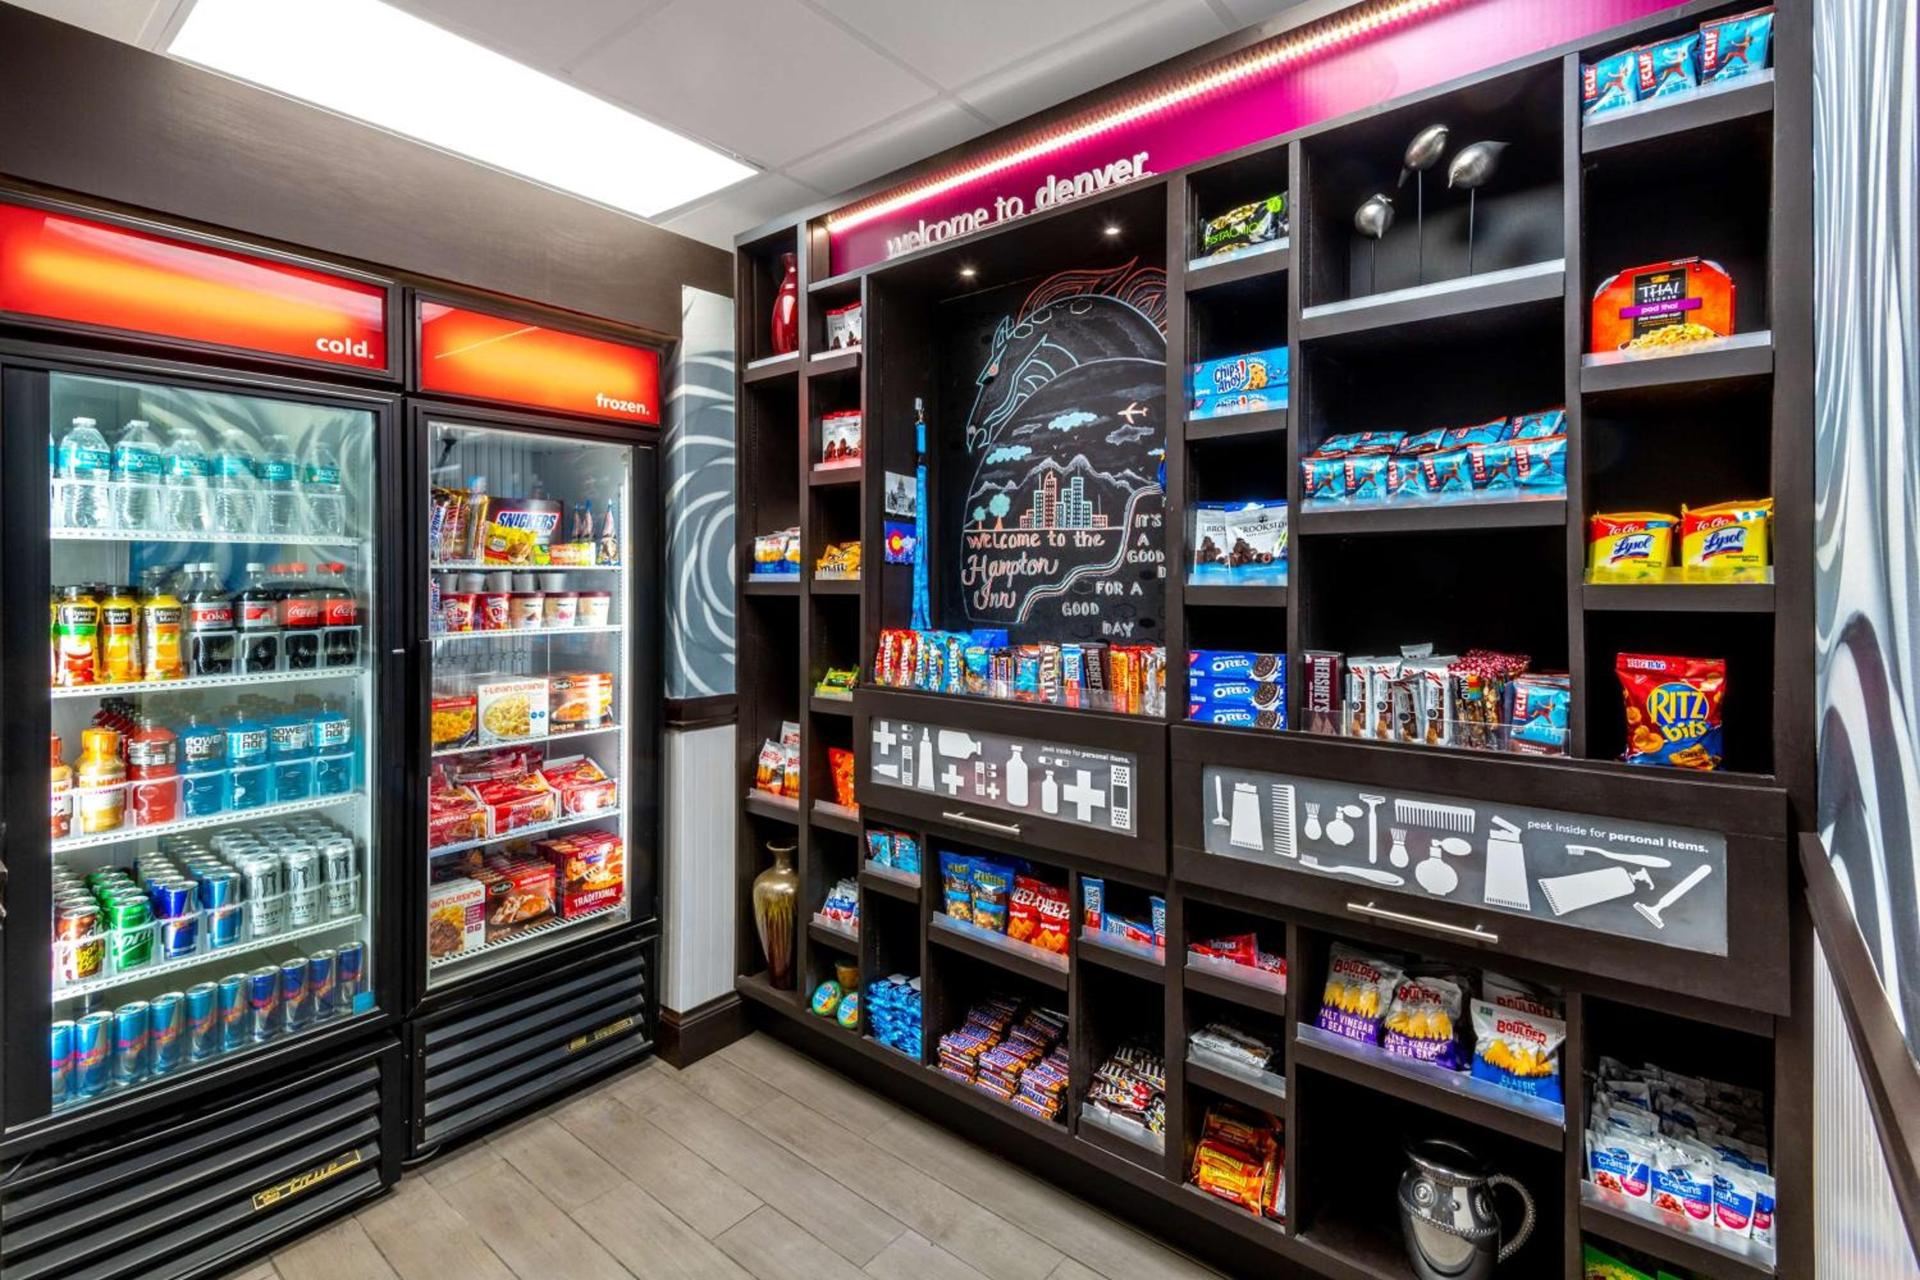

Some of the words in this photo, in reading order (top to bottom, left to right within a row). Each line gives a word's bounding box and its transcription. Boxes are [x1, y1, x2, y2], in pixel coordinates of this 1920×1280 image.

[1705, 31, 1718, 59] CLIF
[1640, 52, 1653, 78] CLIF
[1585, 66, 1597, 90] CLIF
[886, 206, 989, 257] welcome
[994, 196, 1024, 220] to
[1638, 282, 1679, 298] THAI
[1641, 305, 1660, 315] pad
[1661, 302, 1679, 313] thai
[316, 336, 375, 360] cold.
[1214, 362, 1240, 383] Chips
[595, 392, 650, 415] frozen.
[1472, 451, 1485, 473] CLIF
[1516, 446, 1529, 471] CLIF
[1609, 523, 1621, 535] To
[1622, 523, 1639, 533] Go
[1695, 520, 1709, 531] To
[1711, 518, 1729, 527] Go
[967, 531, 1041, 549] welcome
[1048, 530, 1066, 547] to
[1072, 531, 1106, 547] the
[1138, 533, 1150, 546] A
[1613, 534, 1652, 555] Lysol
[1704, 529, 1745, 550] Lysol
[1127, 550, 1165, 564] GOOD
[961, 551, 1060, 588] Hampton
[973, 582, 1017, 611] Inn
[1096, 581, 1124, 596] FOR
[1130, 581, 1143, 596] A
[201, 610, 228, 621] Coke
[1062, 602, 1100, 617] GOOD
[1102, 621, 1135, 637] DAY
[1212, 659, 1250, 671] OREO
[1213, 686, 1251, 698] OREO
[1314, 657, 1330, 713] HERSHEY'S
[1460, 676, 1470, 700] KIND
[1516, 688, 1529, 710] CLIF
[1650, 688, 1705, 724] RITZ
[1214, 713, 1251, 725] OREO
[1661, 719, 1707, 742] bits
[1081, 752, 1109, 761] personal
[1109, 754, 1131, 764] items.
[1527, 820, 1553, 832] peek
[1555, 822, 1587, 836] inside
[1589, 828, 1606, 838] for
[1609, 832, 1664, 847] personal
[1667, 838, 1709, 853] items.
[1333, 959, 1380, 985] BOULDER
[1328, 1020, 1343, 1034] SEA
[1345, 1027, 1367, 1041] SALT
[1340, 1015, 1374, 1034] VINEGAR
[1497, 1020, 1547, 1046] BOULDER
